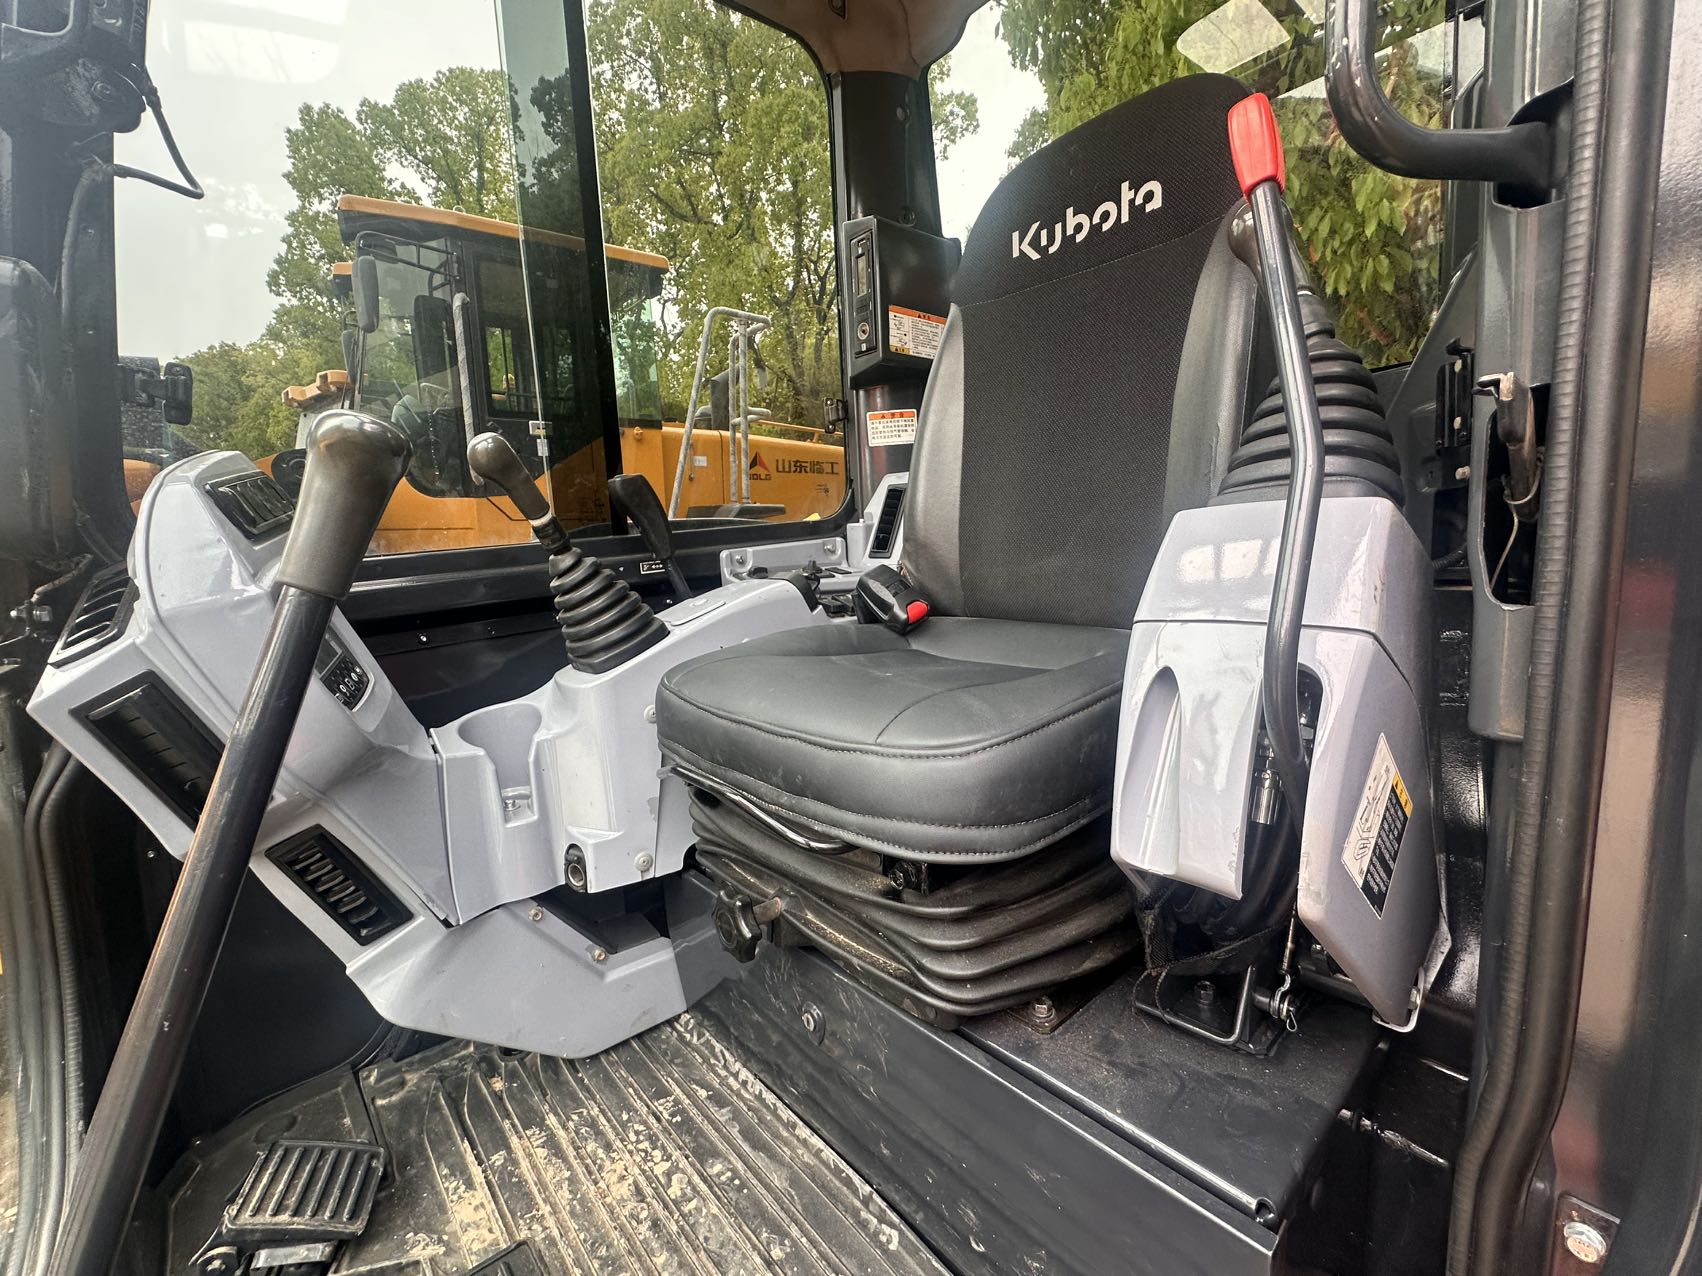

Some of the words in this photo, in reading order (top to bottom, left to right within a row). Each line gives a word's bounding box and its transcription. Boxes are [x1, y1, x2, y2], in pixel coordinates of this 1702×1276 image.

[1011, 180, 1163, 261] Kubota
[775, 458, 840, 475] 山东临工
